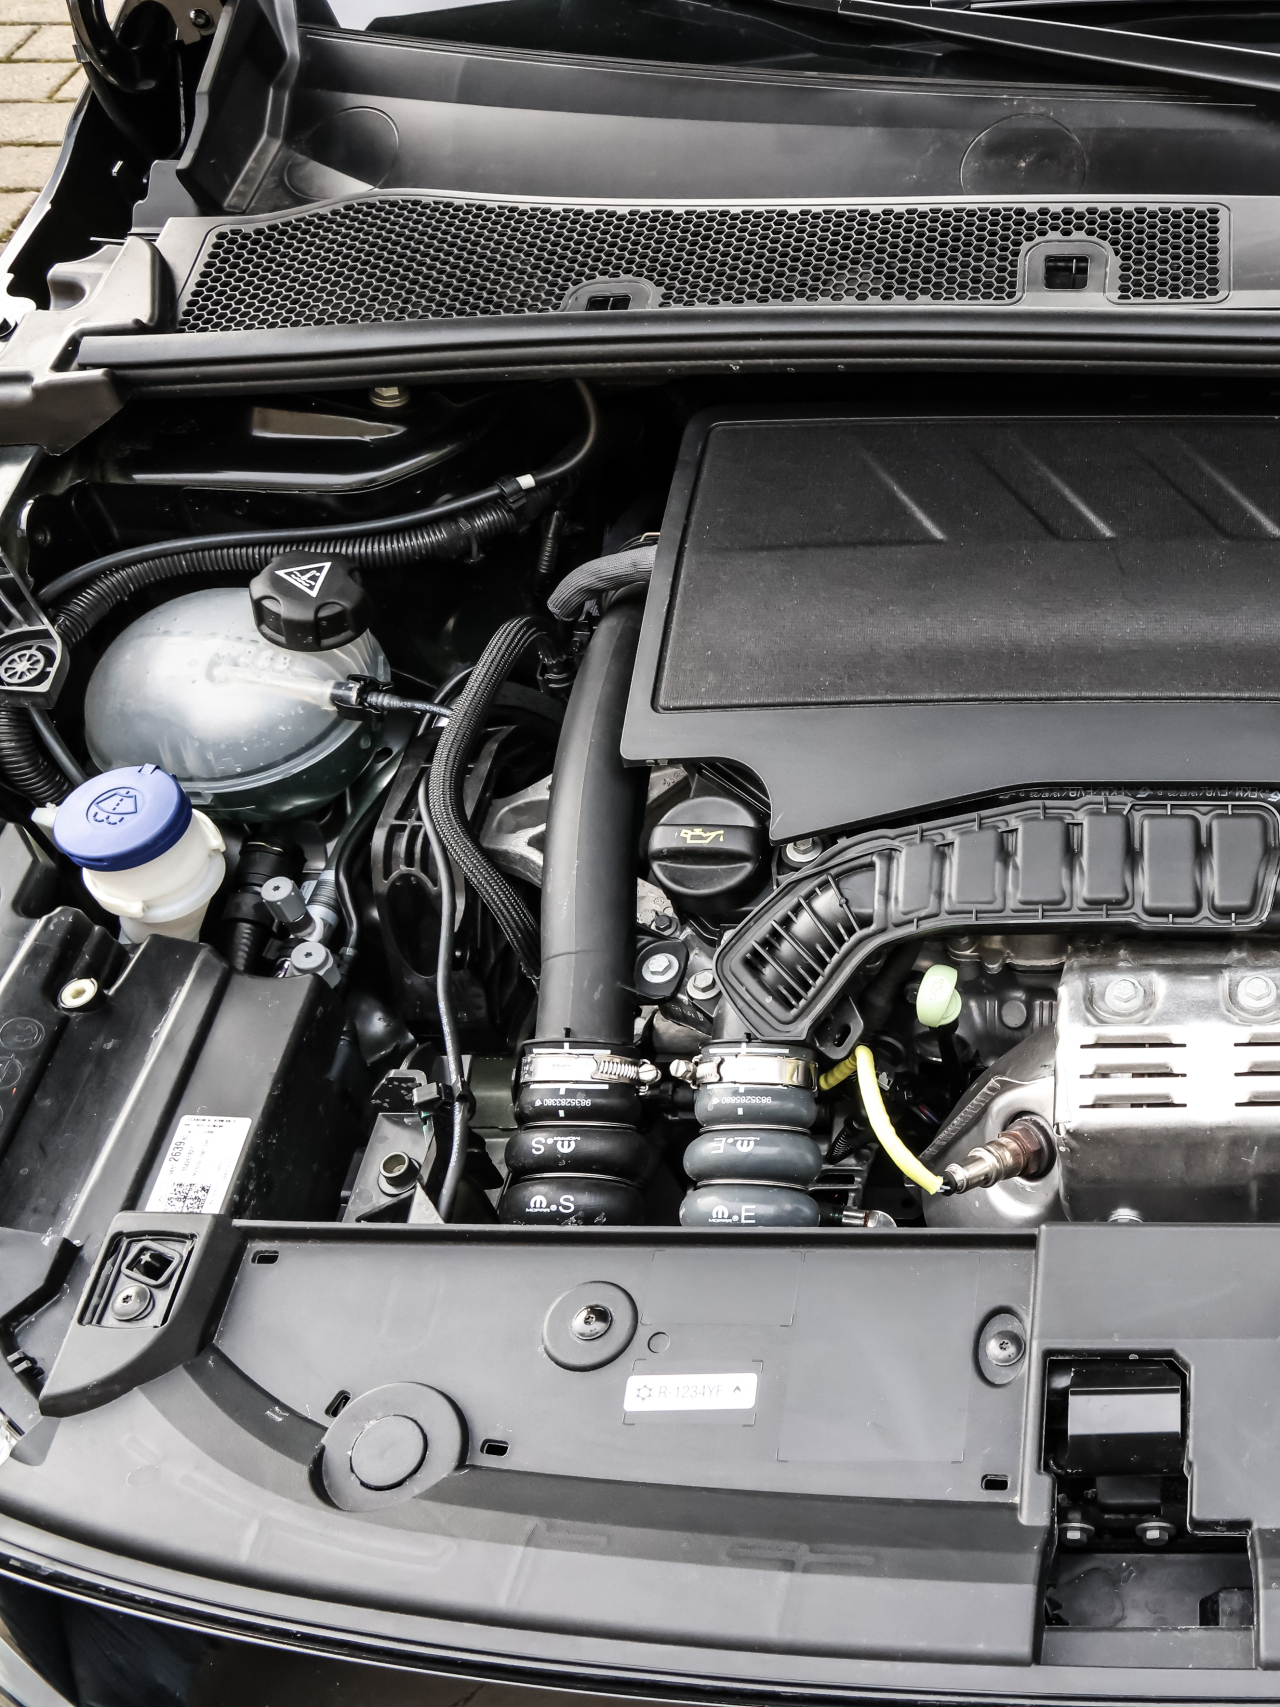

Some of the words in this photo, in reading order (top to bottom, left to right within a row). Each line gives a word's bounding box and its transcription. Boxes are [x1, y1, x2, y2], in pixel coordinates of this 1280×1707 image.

[543, 1098, 591, 1107] 9835283380
[169, 1141, 186, 1162] 2639
[531, 1136, 545, 1155] S
[710, 1137, 725, 1154] E
[559, 1194, 575, 1213] S
[741, 1205, 756, 1223] E
[658, 1384, 723, 1399] R-1234YF
